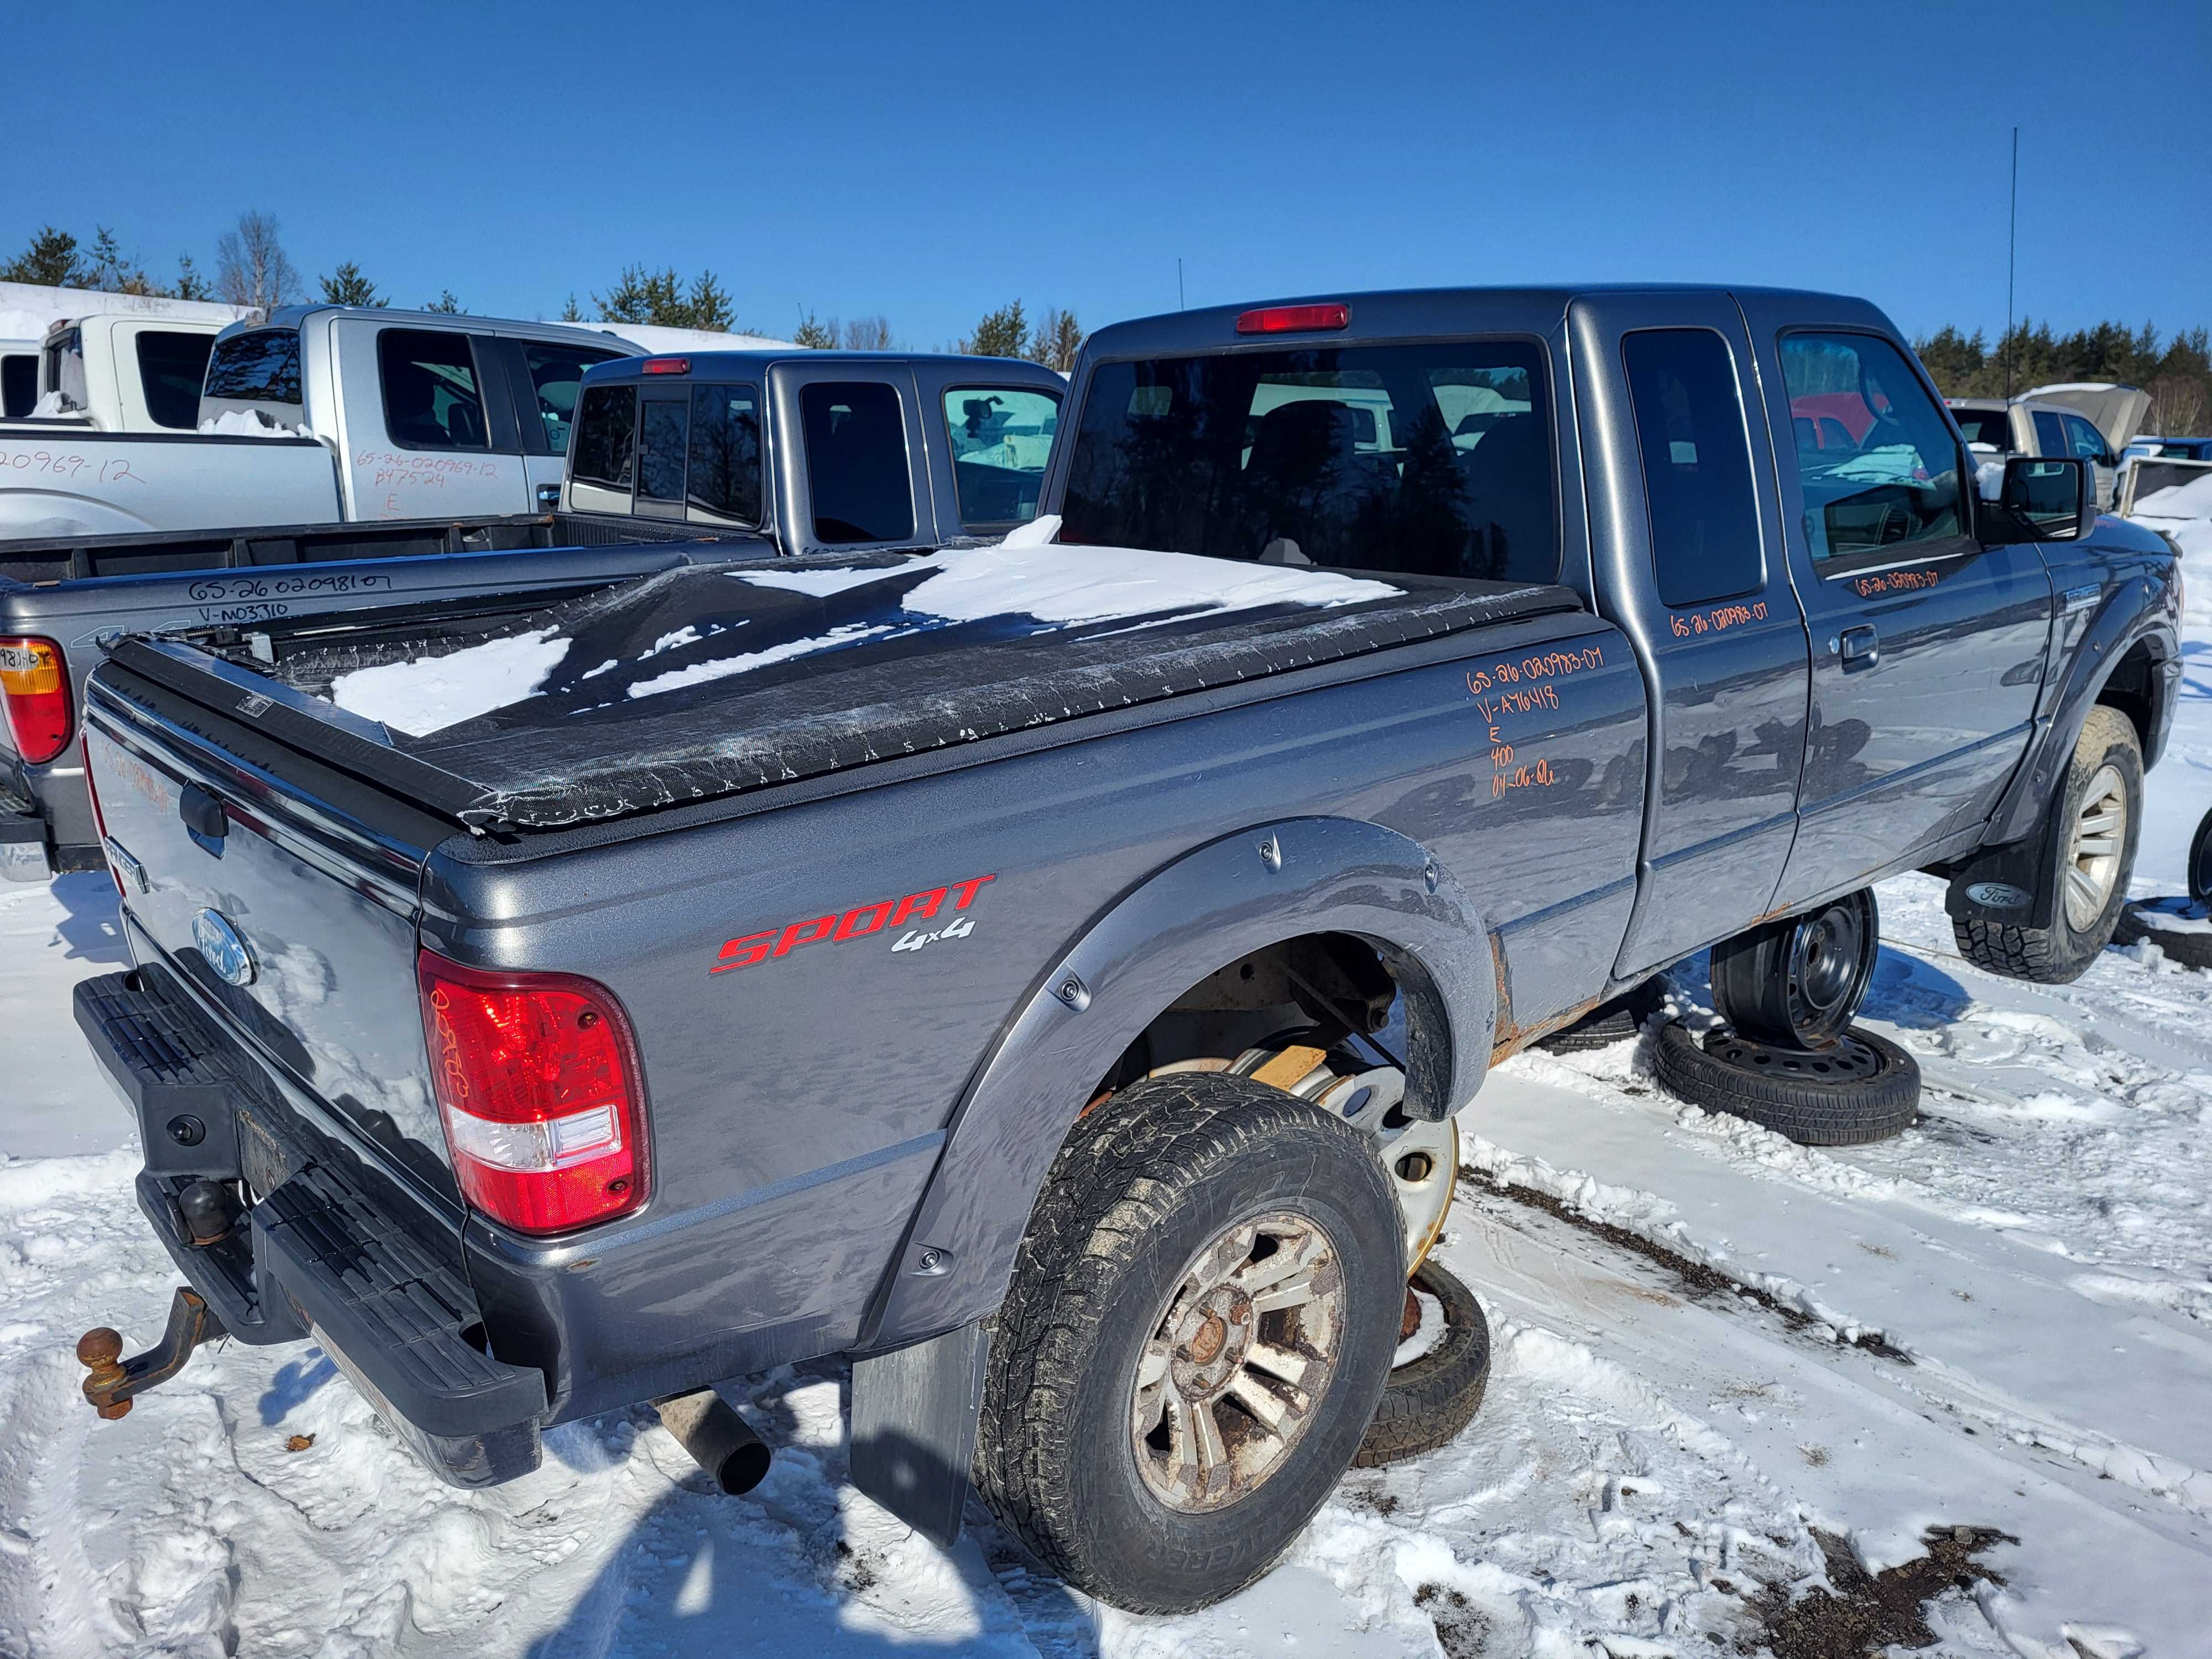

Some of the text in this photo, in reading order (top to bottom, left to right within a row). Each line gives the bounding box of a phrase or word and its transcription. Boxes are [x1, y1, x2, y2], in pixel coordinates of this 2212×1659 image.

[387, 493, 399, 512] E
[1489, 726, 1503, 744] E
[1490, 744, 1514, 772] 400
[1980, 886, 2021, 905] Ford
[709, 873, 997, 974] SPORT
[891, 916, 978, 954] 4x4
